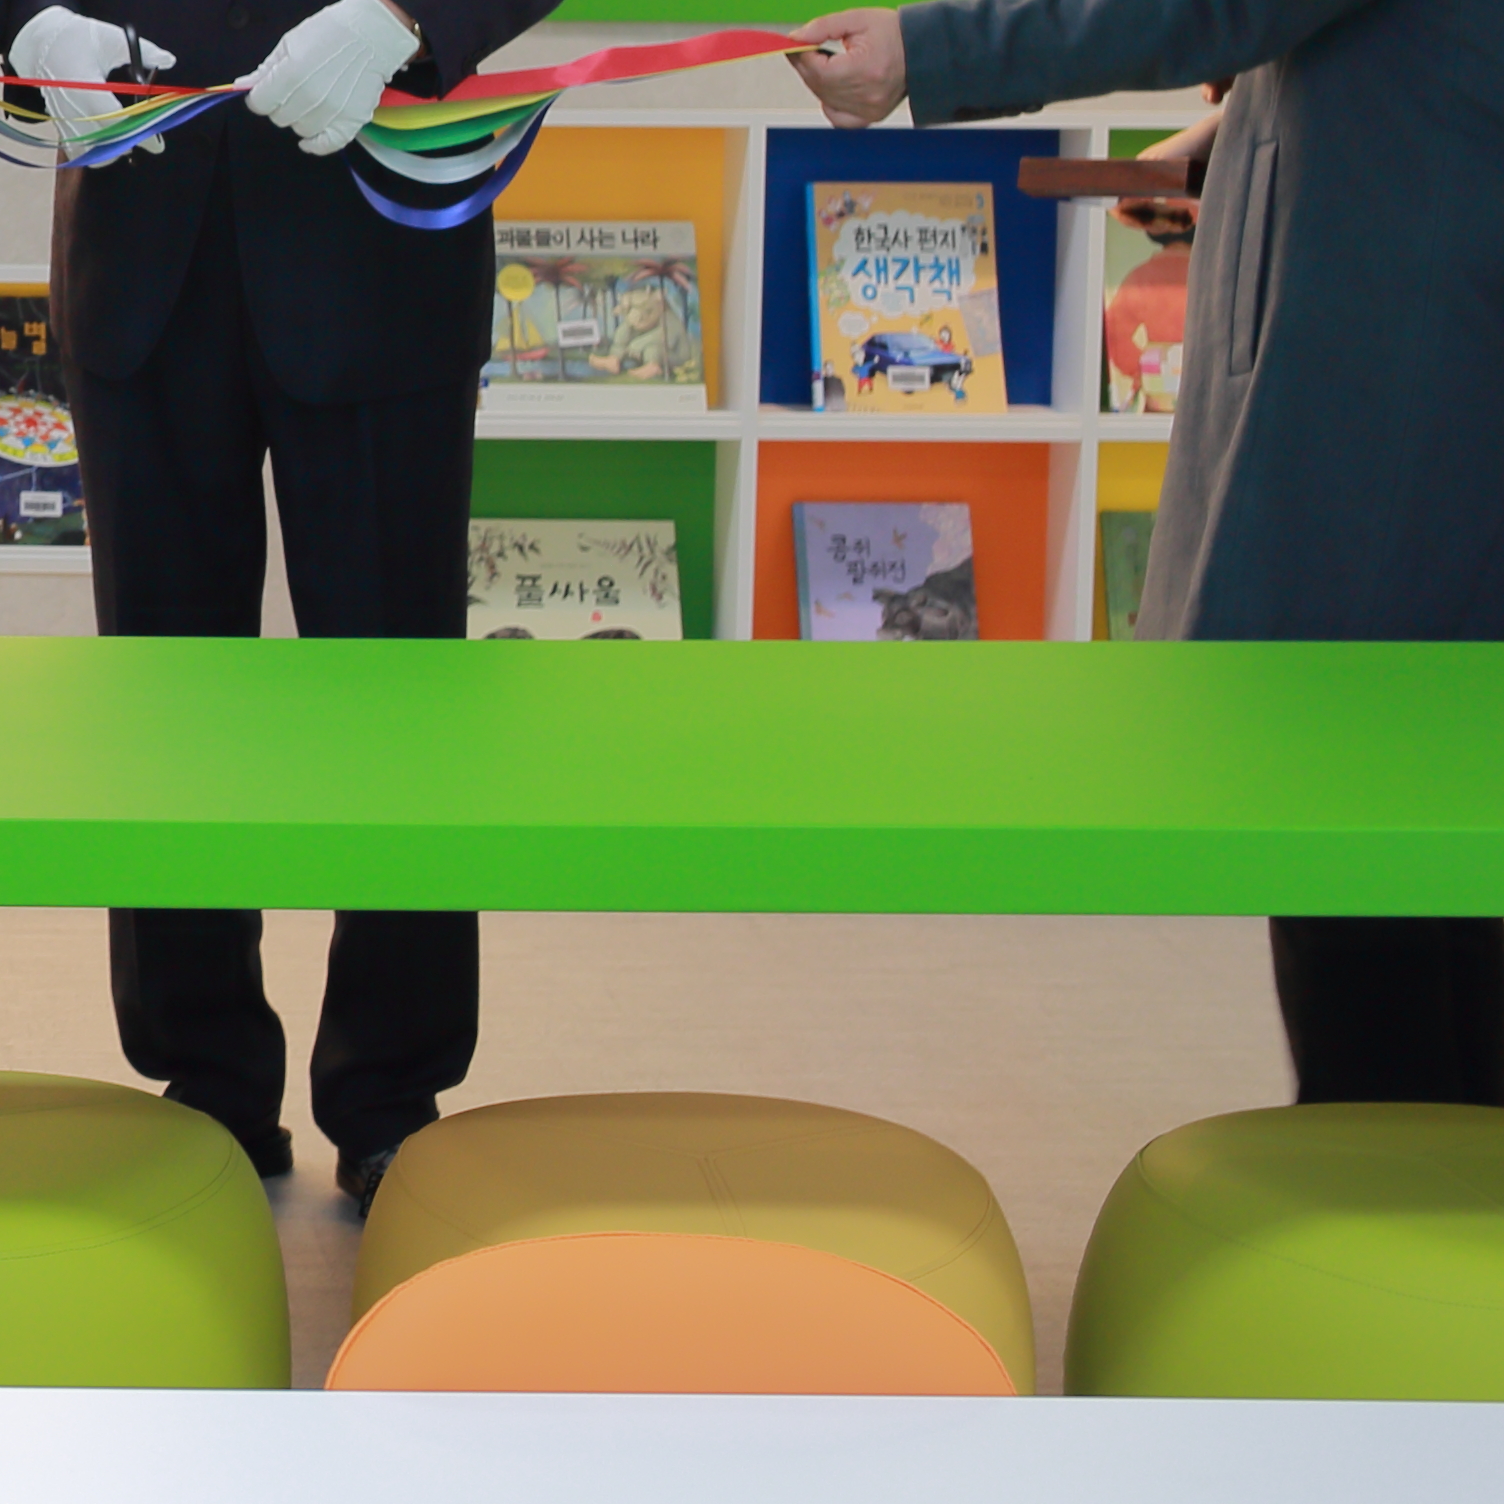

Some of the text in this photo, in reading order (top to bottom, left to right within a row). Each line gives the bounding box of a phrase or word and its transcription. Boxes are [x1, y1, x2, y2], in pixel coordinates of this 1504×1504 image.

[576, 227, 616, 251] 사는
[621, 227, 659, 251] 나라
[854, 224, 957, 253] 한국사 편지
[851, 255, 962, 304] 생각책
[826, 533, 871, 563] 콩쥐
[845, 557, 907, 585] 팥쥐전
